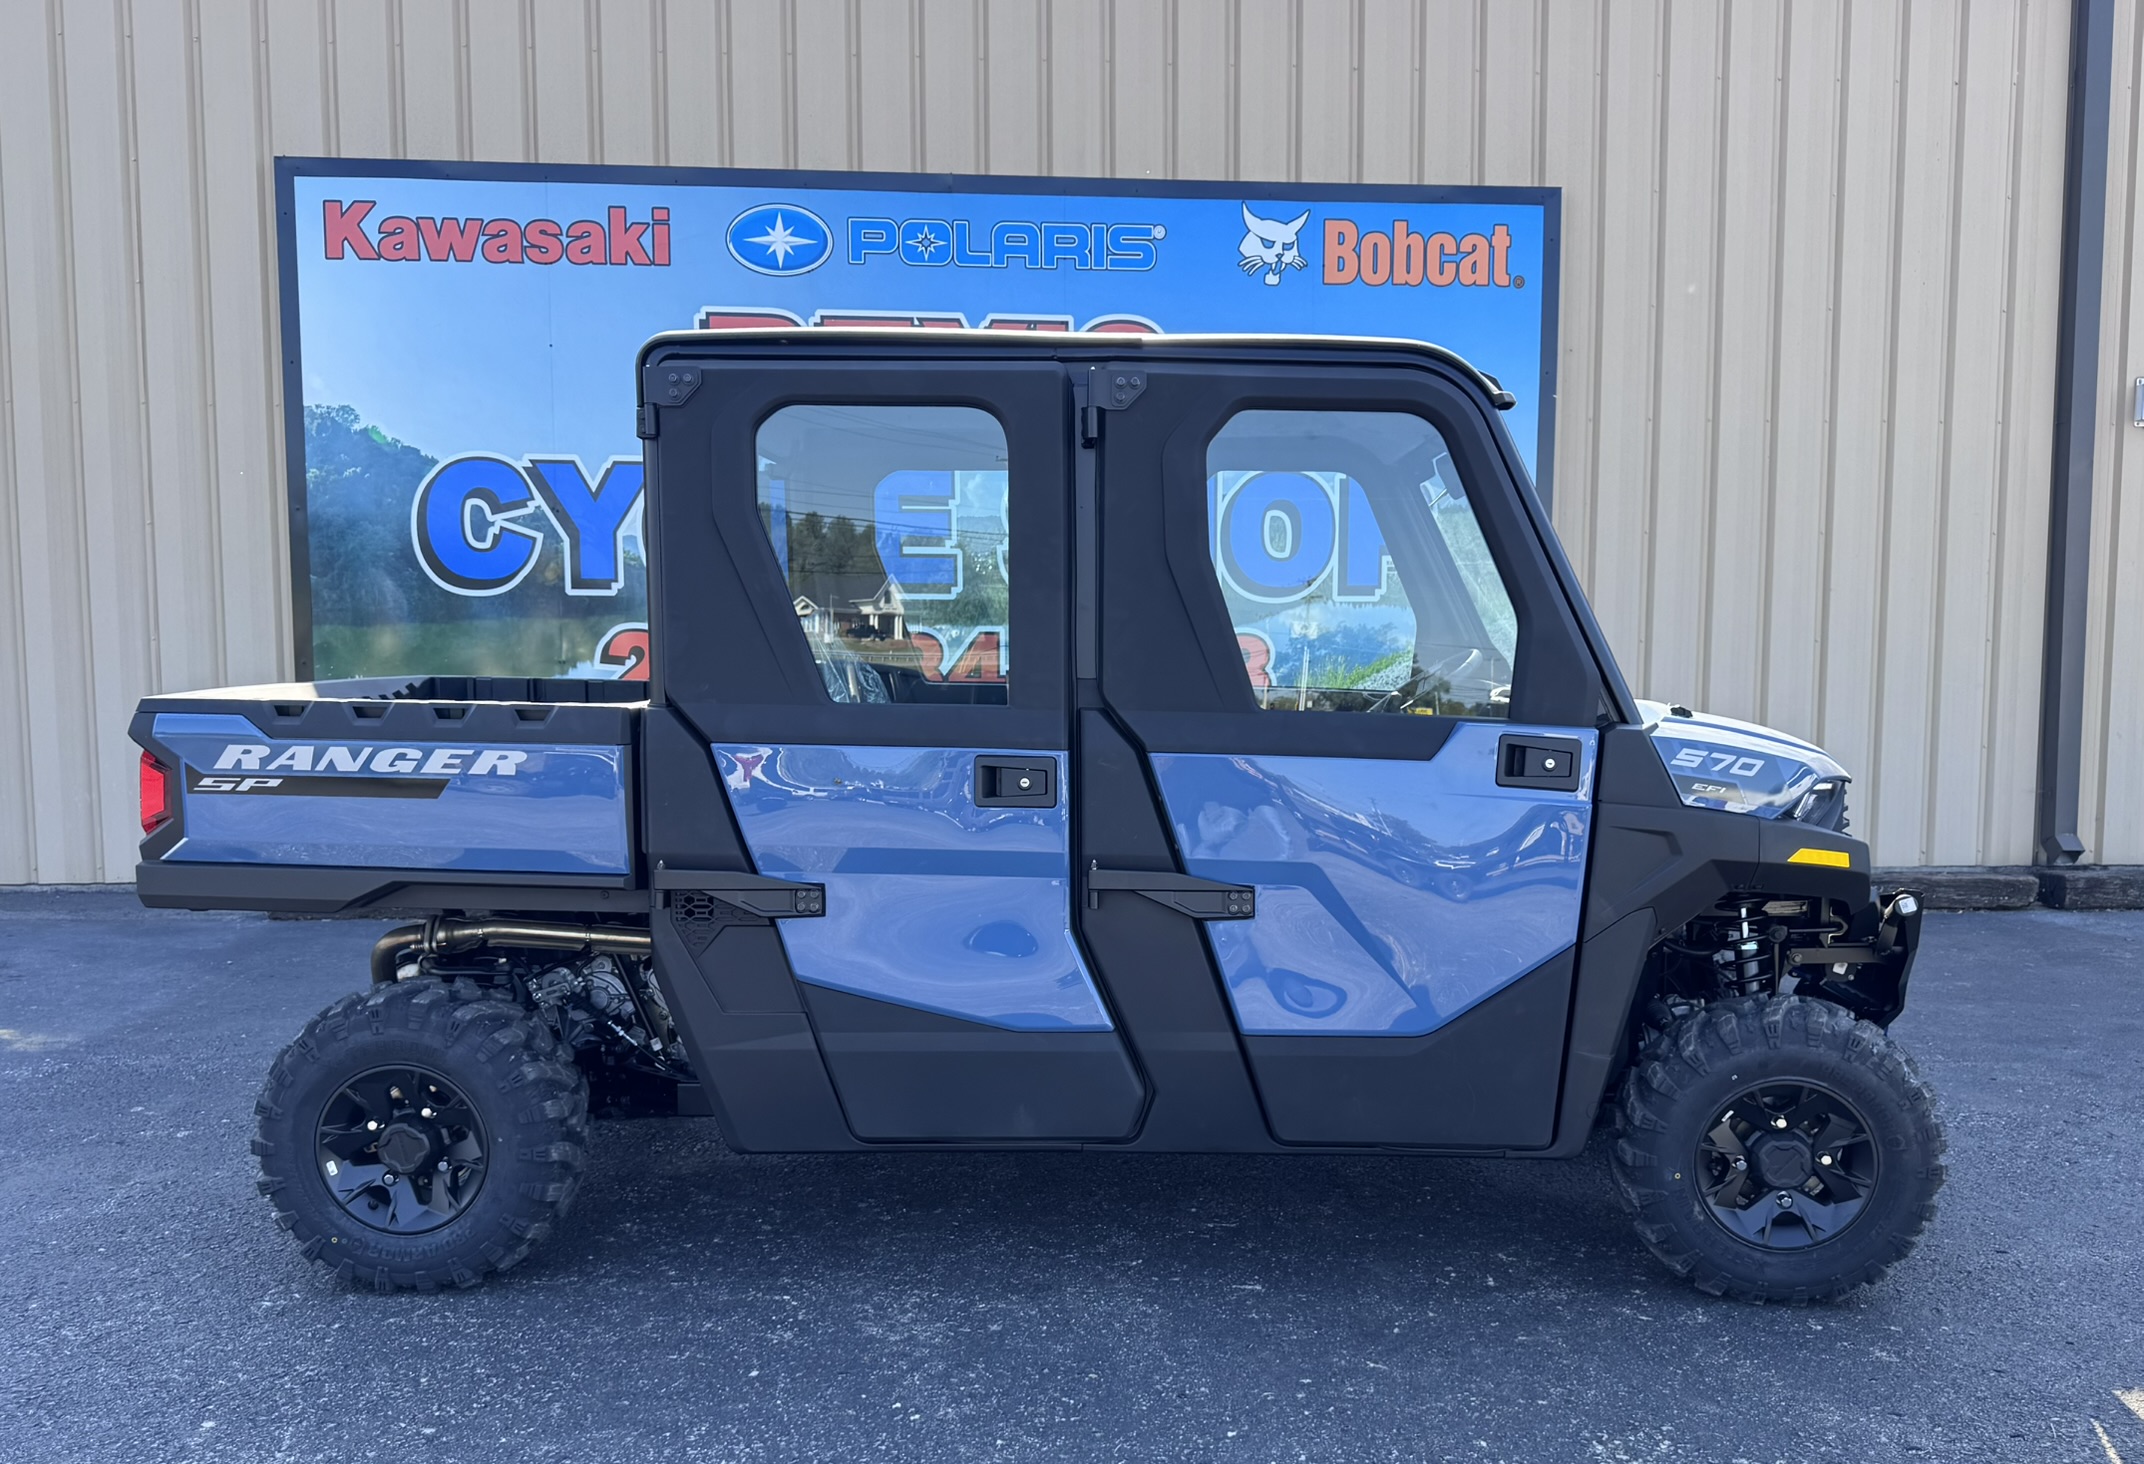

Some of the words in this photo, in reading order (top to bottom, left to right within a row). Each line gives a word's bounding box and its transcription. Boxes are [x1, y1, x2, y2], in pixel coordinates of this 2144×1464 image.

[323, 199, 671, 267] Kawasaki
[847, 217, 1158, 271] POLARIS
[1322, 218, 1512, 288] Bobcat
[213, 744, 528, 777] RANGER
[1670, 747, 1765, 777] 570
[193, 777, 284, 792] SP
[1691, 783, 1727, 794] EFI
